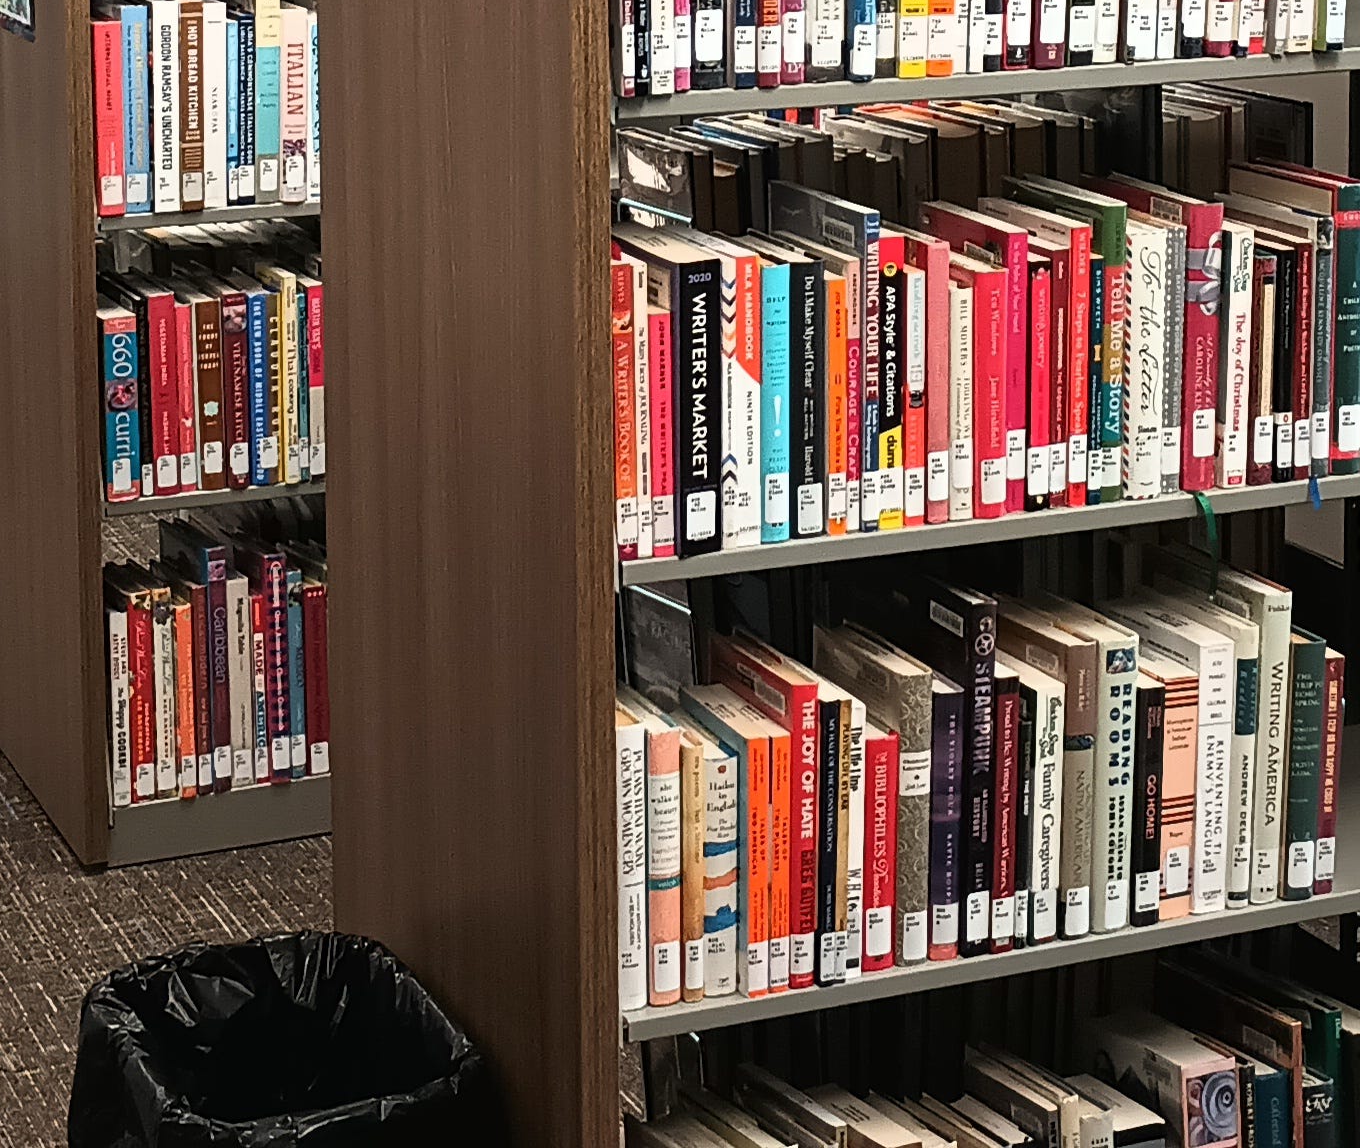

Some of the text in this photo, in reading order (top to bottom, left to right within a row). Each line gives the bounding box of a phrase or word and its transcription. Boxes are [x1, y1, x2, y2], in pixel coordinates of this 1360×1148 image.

[161, 25, 172, 170] GORDON RAMSAY'S UNCHARTED
[188, 26, 198, 129] HOT BREAD KITCHEN
[287, 43, 303, 115] ITALIAN
[744, 264, 753, 289] MLA
[803, 276, 814, 290] Do
[803, 297, 815, 324] Make
[885, 286, 896, 312] APA
[112, 334, 131, 377] 660
[253, 301, 263, 413] THE NEW BOOK OF MIDDLE
[744, 293, 754, 360] HANDBOOK
[801, 326, 816, 360] Myself
[866, 242, 880, 396] WRITING YOUR LIFE
[886, 350, 897, 360] &
[1105, 273, 1125, 435] Tell Me a Story
[1138, 246, 1162, 417] To the Letter
[233, 342, 242, 408] VIETNAMESE
[617, 340, 633, 482] A WRITER'S BOOK OF
[688, 274, 712, 479] 2020 WRITER'S MARKET
[803, 362, 816, 388] Clear
[885, 363, 897, 417] Citations
[1232, 313, 1246, 432] The Joy of Christmas
[803, 446, 815, 475] Harold
[213, 607, 226, 683] Caribbean
[236, 598, 244, 633] Magnolia
[255, 640, 266, 748] MADE AMERIC
[973, 663, 992, 776] STEAMPUNK
[1108, 684, 1121, 786] ROOMS
[1121, 684, 1132, 786] READING
[1206, 735, 1215, 794] ENEMY'S
[1240, 754, 1249, 806] ANDREW
[1264, 662, 1284, 826] WRITING AMERICA
[800, 700, 815, 884] THE JOY OF HATE GREG
[873, 765, 888, 858] BIBLIOPHILES
[1037, 763, 1055, 891] Family Caregivers
[1145, 775, 1158, 840] GO HOME!
[1214, 740, 1224, 834] REINVENTING
